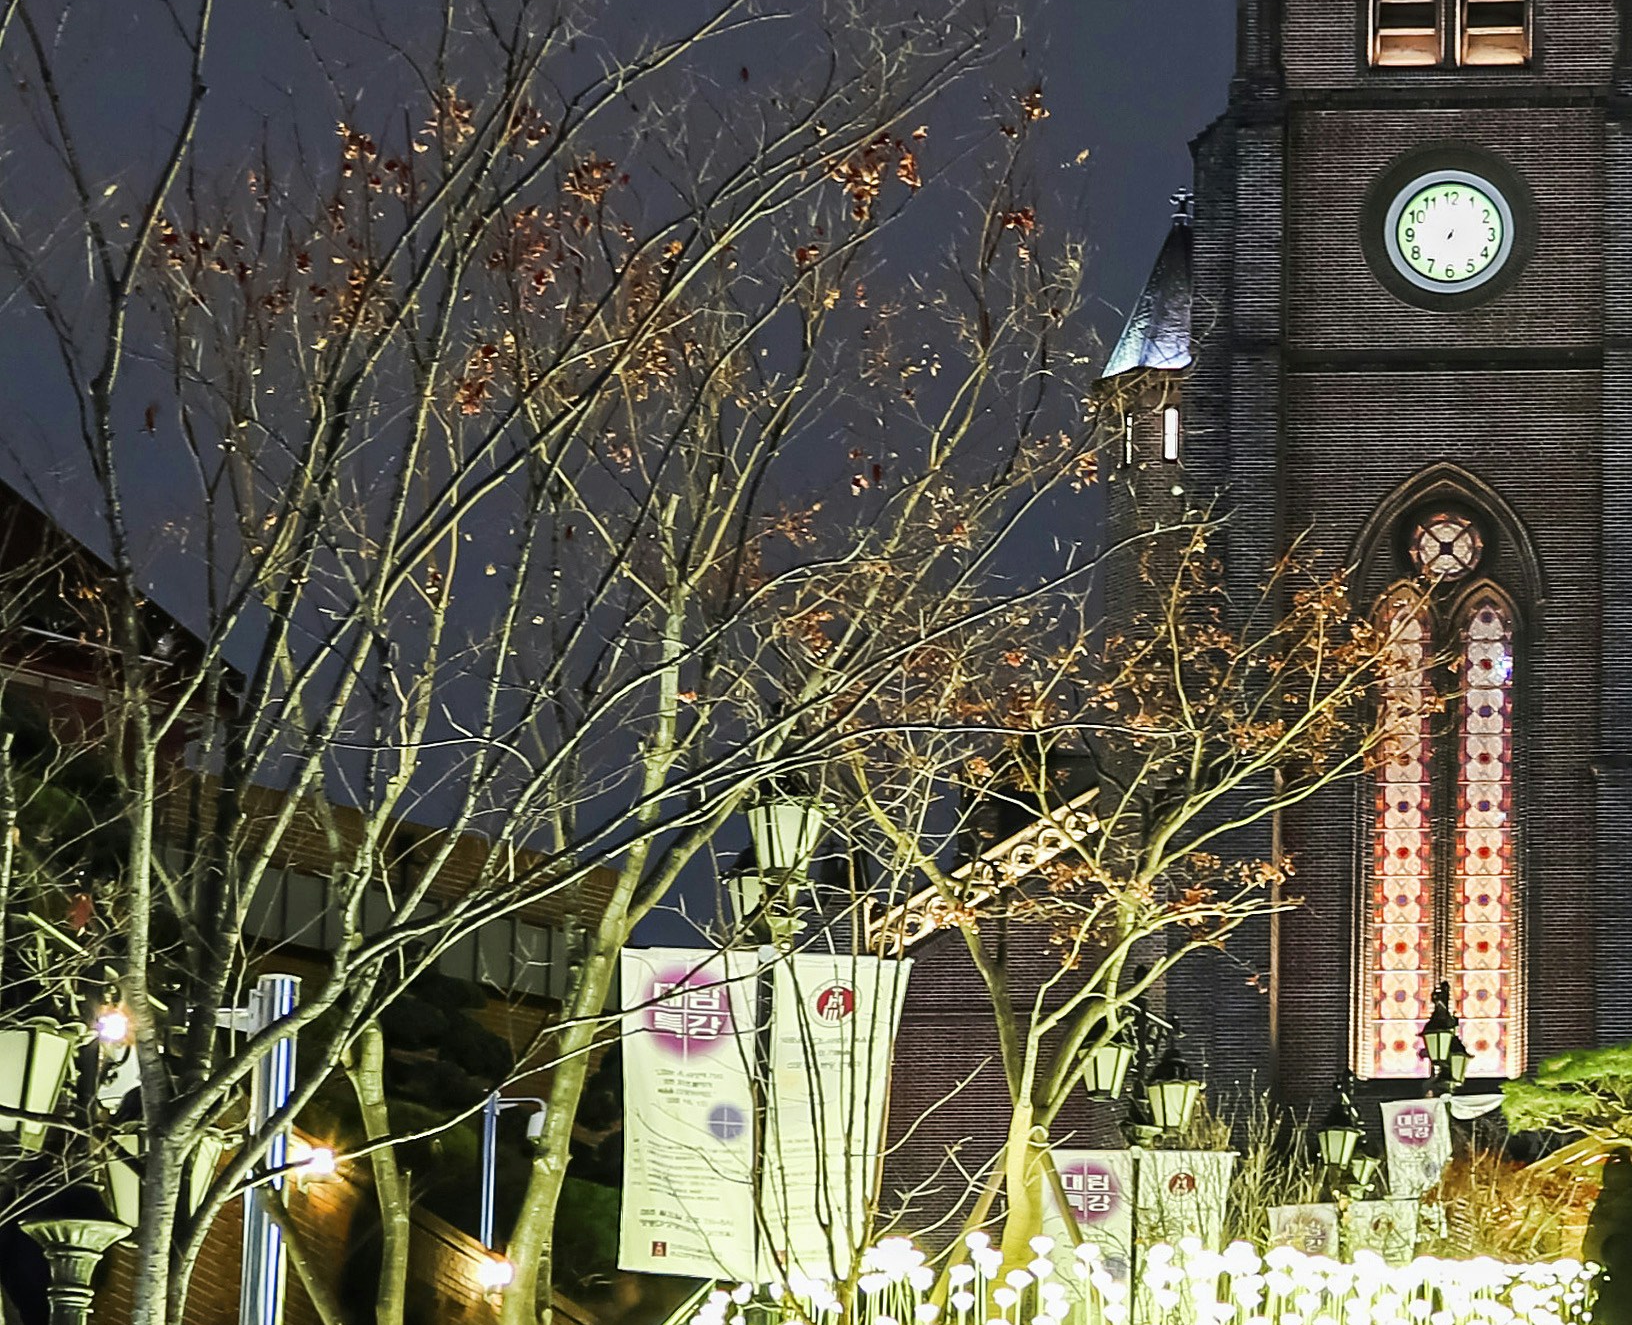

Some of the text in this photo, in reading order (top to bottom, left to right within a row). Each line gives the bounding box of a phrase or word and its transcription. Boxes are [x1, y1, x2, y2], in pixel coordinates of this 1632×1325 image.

[1422, 196, 1436, 210] 11
[1443, 191, 1459, 205] 12
[1469, 196, 1475, 207] 1
[1409, 209, 1426, 224] 10
[1482, 209, 1491, 224] 2
[1405, 228, 1415, 242] 9
[1487, 227, 1496, 242] 3
[1411, 245, 1421, 260] 8
[1480, 245, 1489, 259] 4
[1427, 258, 1436, 273] 7
[1445, 264, 1455, 278] 6
[1465, 258, 1475, 273] 5
[653, 1011, 722, 1040] 특강
